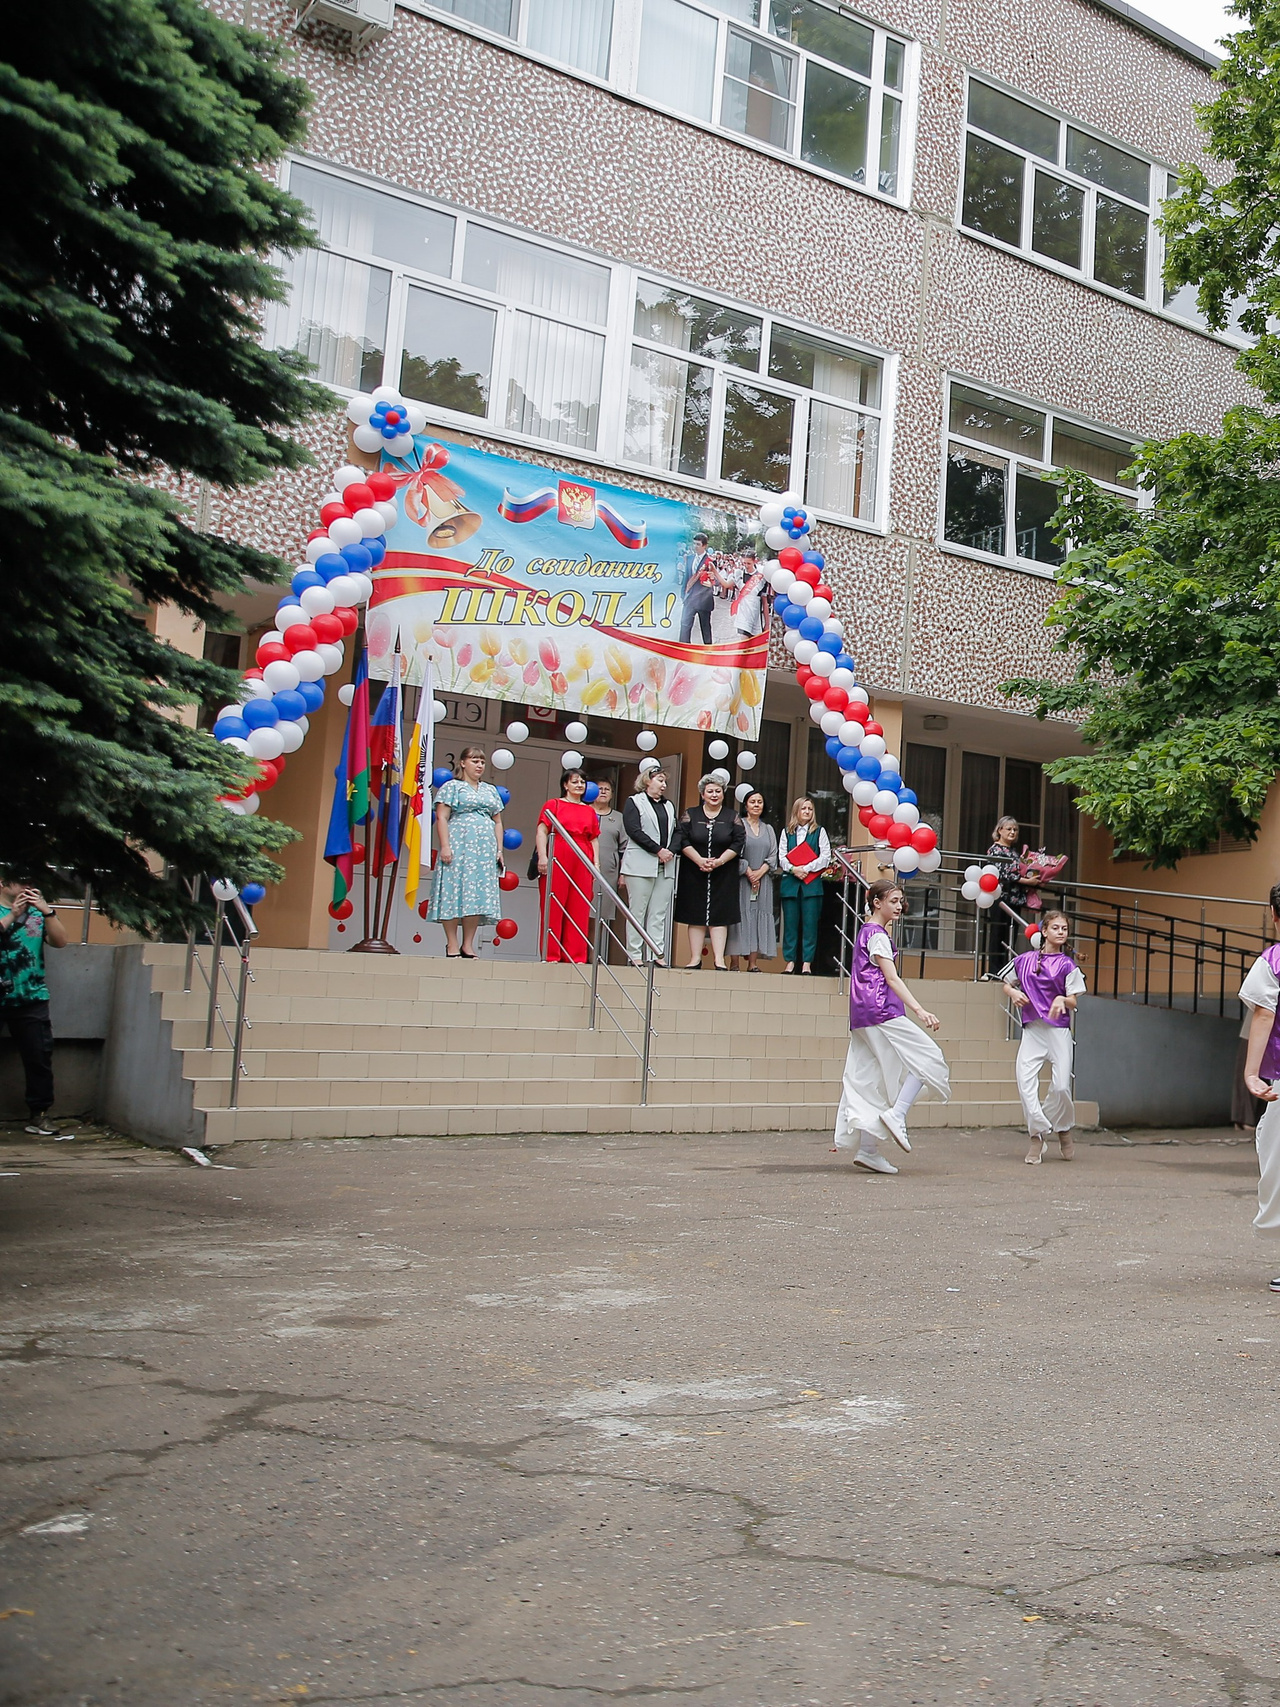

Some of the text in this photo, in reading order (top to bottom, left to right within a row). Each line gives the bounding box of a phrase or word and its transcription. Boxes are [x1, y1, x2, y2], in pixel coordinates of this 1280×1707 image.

[464, 548, 663, 584] До свидания,
[433, 586, 677, 628] ШКОЛА!
